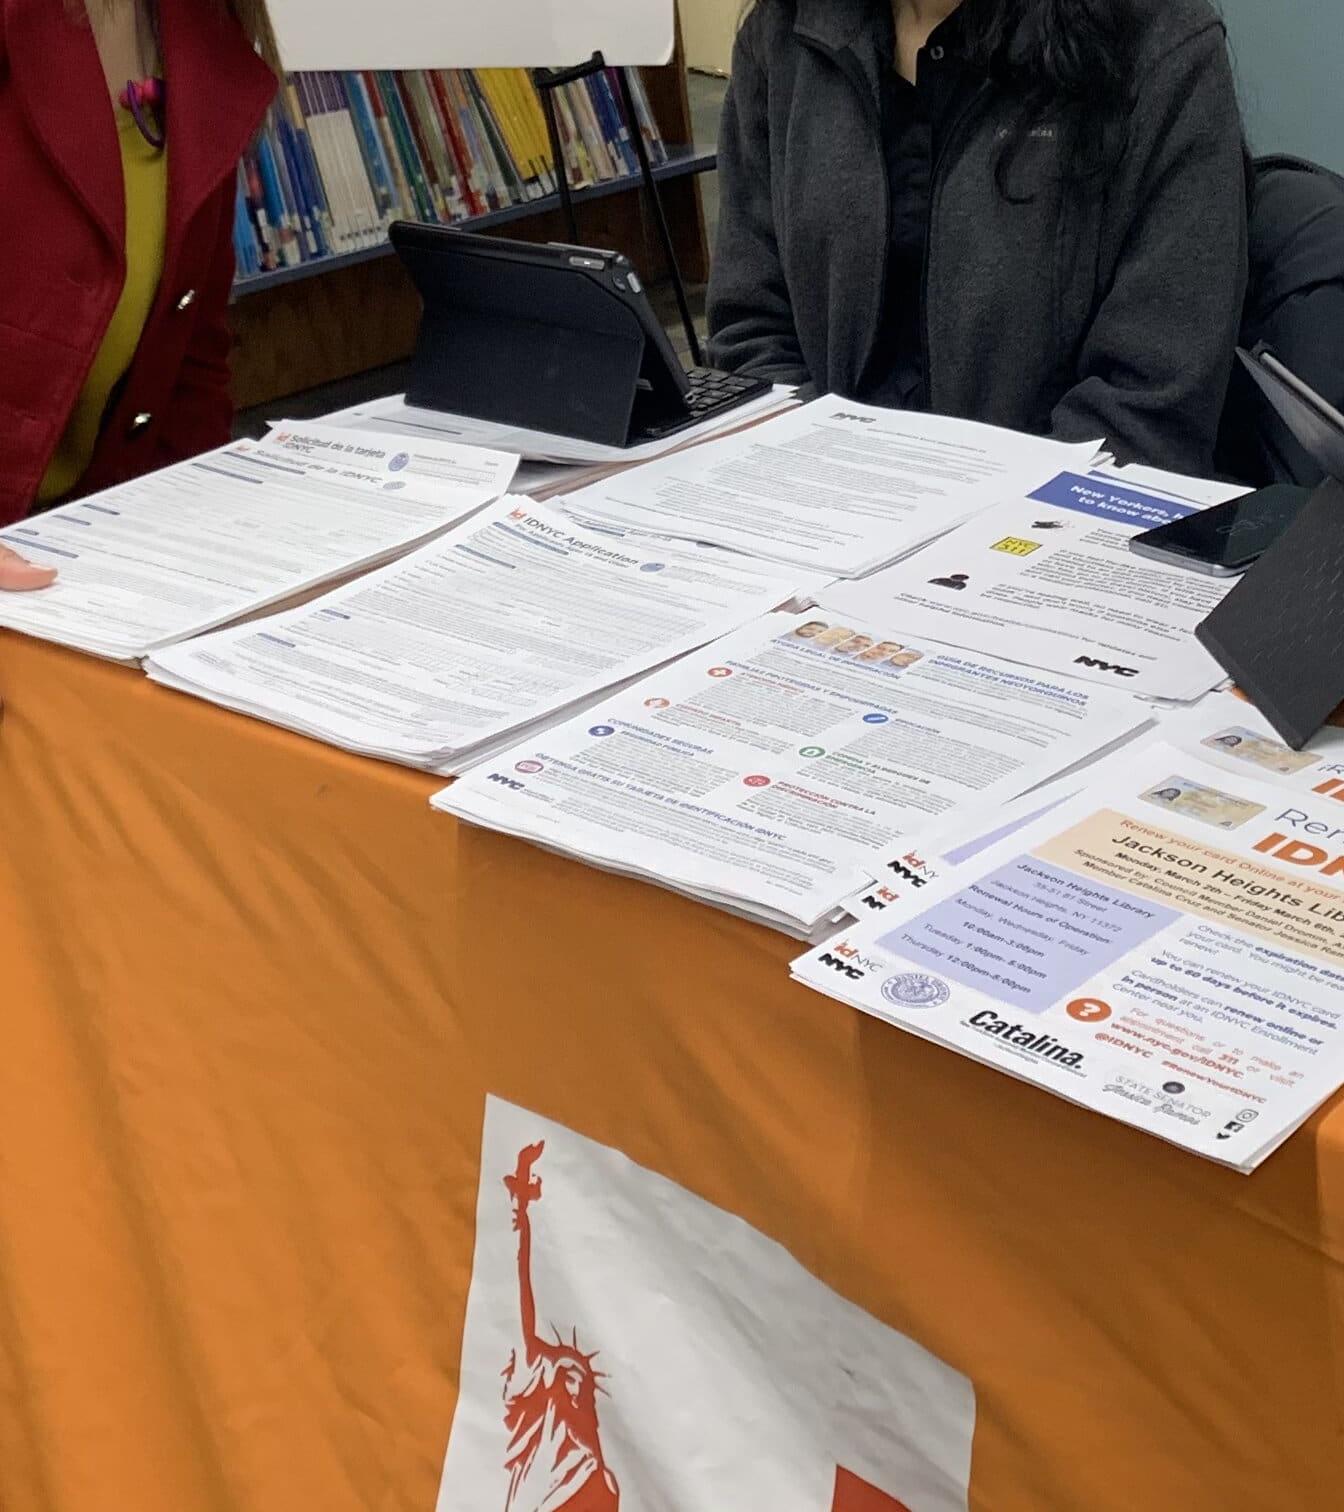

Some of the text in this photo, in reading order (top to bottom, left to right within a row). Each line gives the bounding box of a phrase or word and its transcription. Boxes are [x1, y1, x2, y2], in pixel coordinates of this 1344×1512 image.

[291, 434, 331, 449] Solicitud
[331, 442, 343, 451] de
[356, 446, 386, 459] tarjeta
[1078, 496, 1171, 524] to know abo
[523, 517, 565, 537] IDNYC
[567, 536, 639, 565] Application
[1073, 655, 1140, 677] NYC
[487, 772, 525, 791] NYC
[887, 860, 928, 888] NYC
[1112, 836, 1209, 874] Jackson
[1211, 868, 1304, 908] Heights
[1120, 819, 1165, 840] Renew
[1167, 837, 1204, 852] your
[1203, 849, 1234, 865] card
[1238, 862, 1286, 883] Online
[1288, 879, 1304, 888] at
[1306, 886, 1343, 901] your
[1017, 864, 1156, 919] Jackson Heights Library
[1082, 860, 1128, 881] Member
[1128, 877, 1173, 898] Catalina
[1175, 894, 1202, 907] Cruz
[1202, 903, 1226, 915] and
[1231, 911, 1273, 933] Senator
[1273, 931, 1319, 951] Jessica
[818, 953, 865, 980] NYC
[1197, 924, 1232, 941] Check
[1234, 937, 1257, 948] the
[1255, 945, 1318, 972] expiration
[1131, 969, 1325, 1046] Cardholders can renew online or
[1151, 957, 1338, 1030] up to 60 days before it expires.
[1161, 949, 1343, 1020] You can renew your IDNYC card
[968, 1009, 1084, 1070] Catalina.
[1120, 974, 1319, 1056] in person at an IDNYC Enrollment
